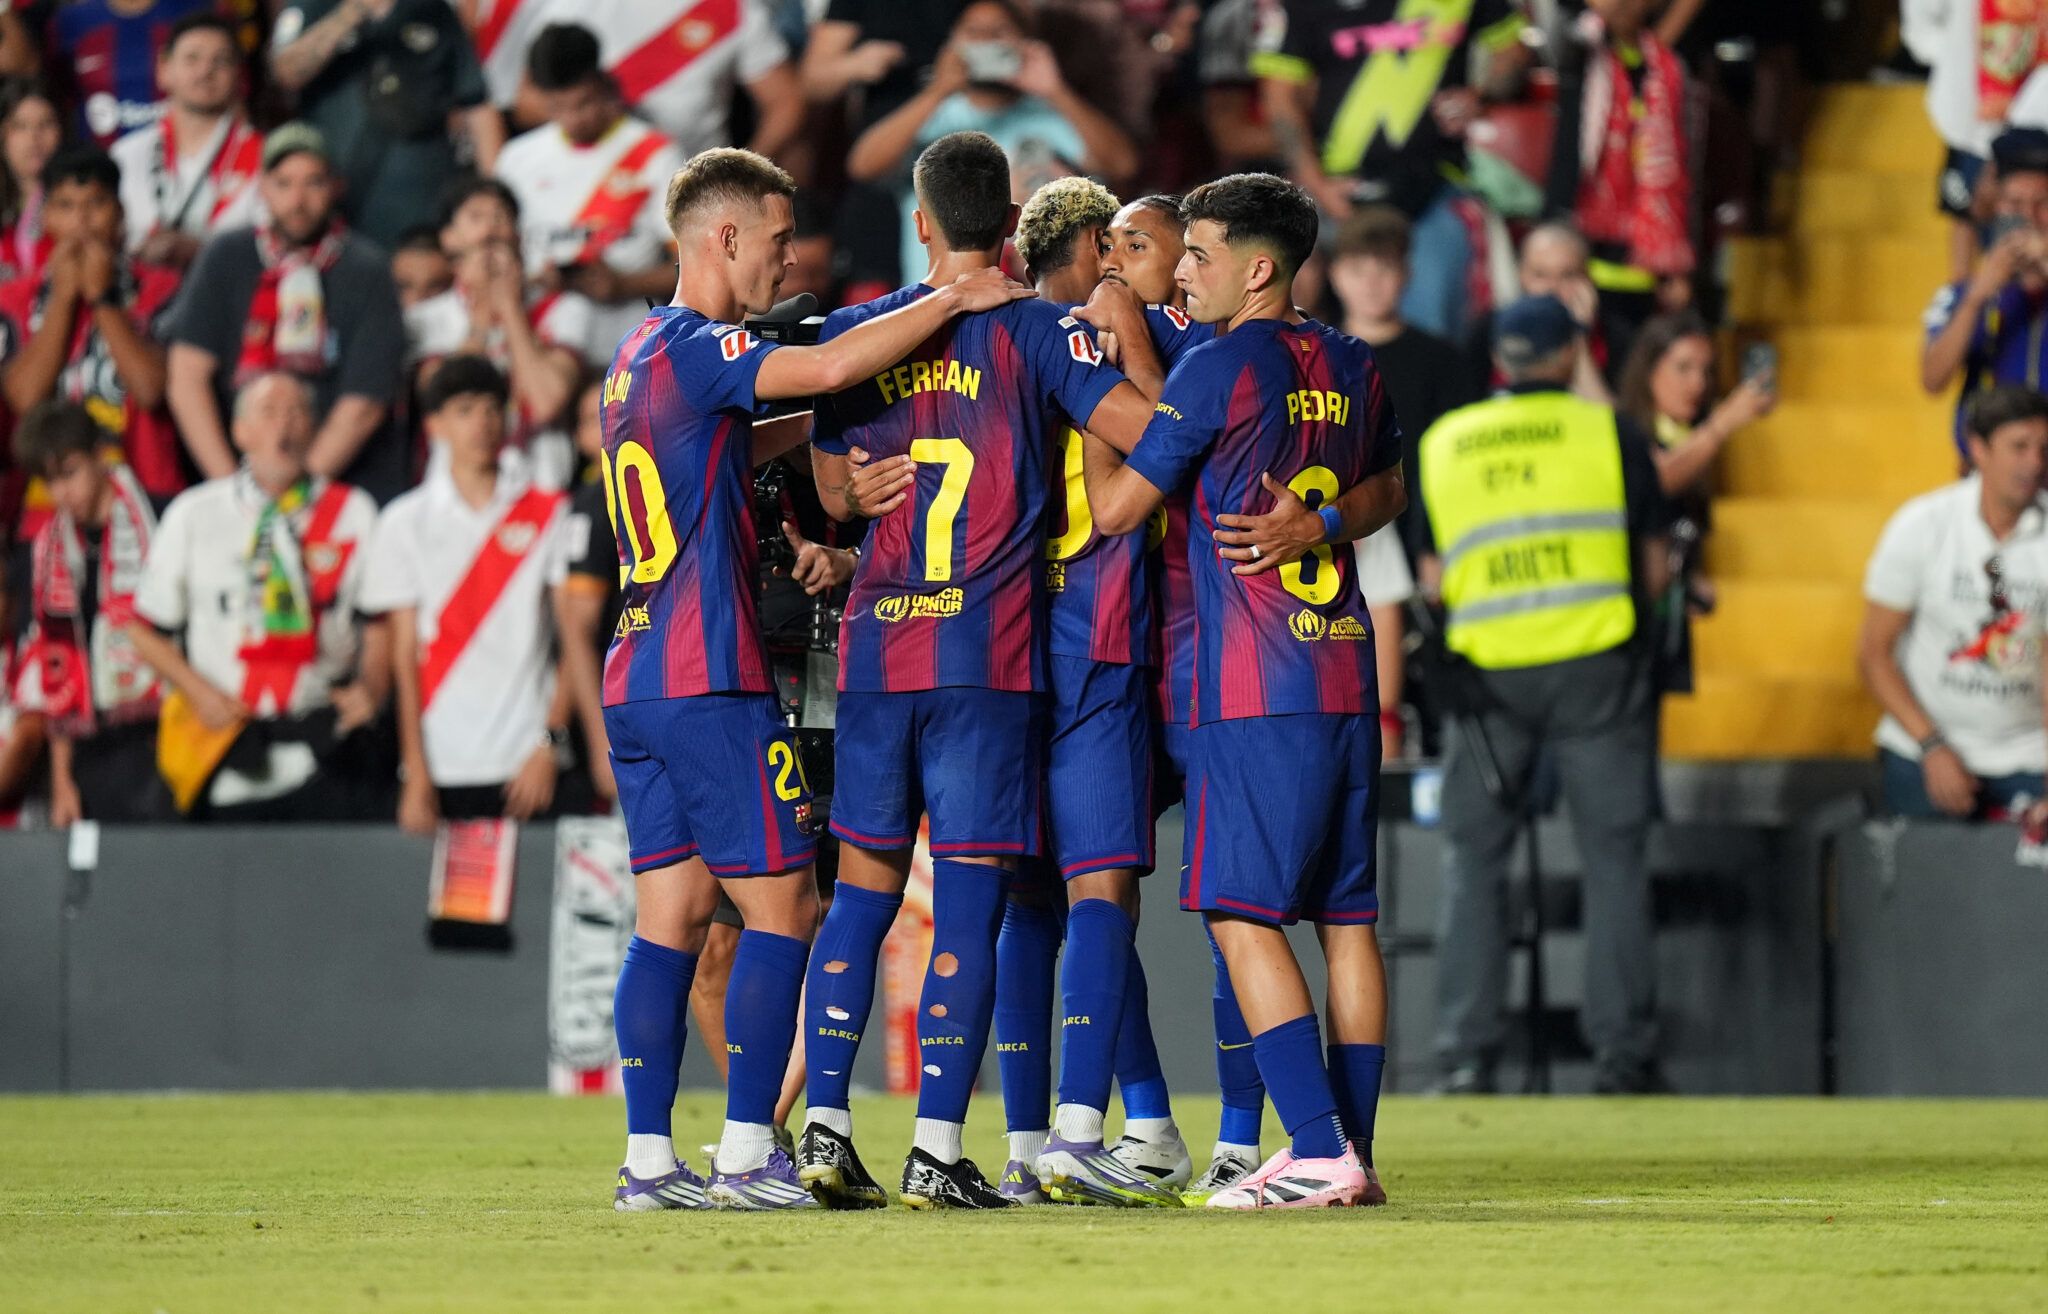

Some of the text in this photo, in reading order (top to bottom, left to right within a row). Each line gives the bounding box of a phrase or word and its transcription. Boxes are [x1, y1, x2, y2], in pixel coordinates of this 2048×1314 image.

[603, 370, 632, 408] OLMO
[875, 359, 982, 405] FERRAN
[1286, 389, 1350, 427] PEDRI
[910, 437, 975, 582] 7
[1487, 538, 1574, 586] ARIETE
[1329, 622, 1367, 635] ACNUR
[818, 1027, 859, 1042] BARÇA
[921, 1036, 964, 1046] BARÇA
[1062, 1016, 1091, 1028] ARÇA
